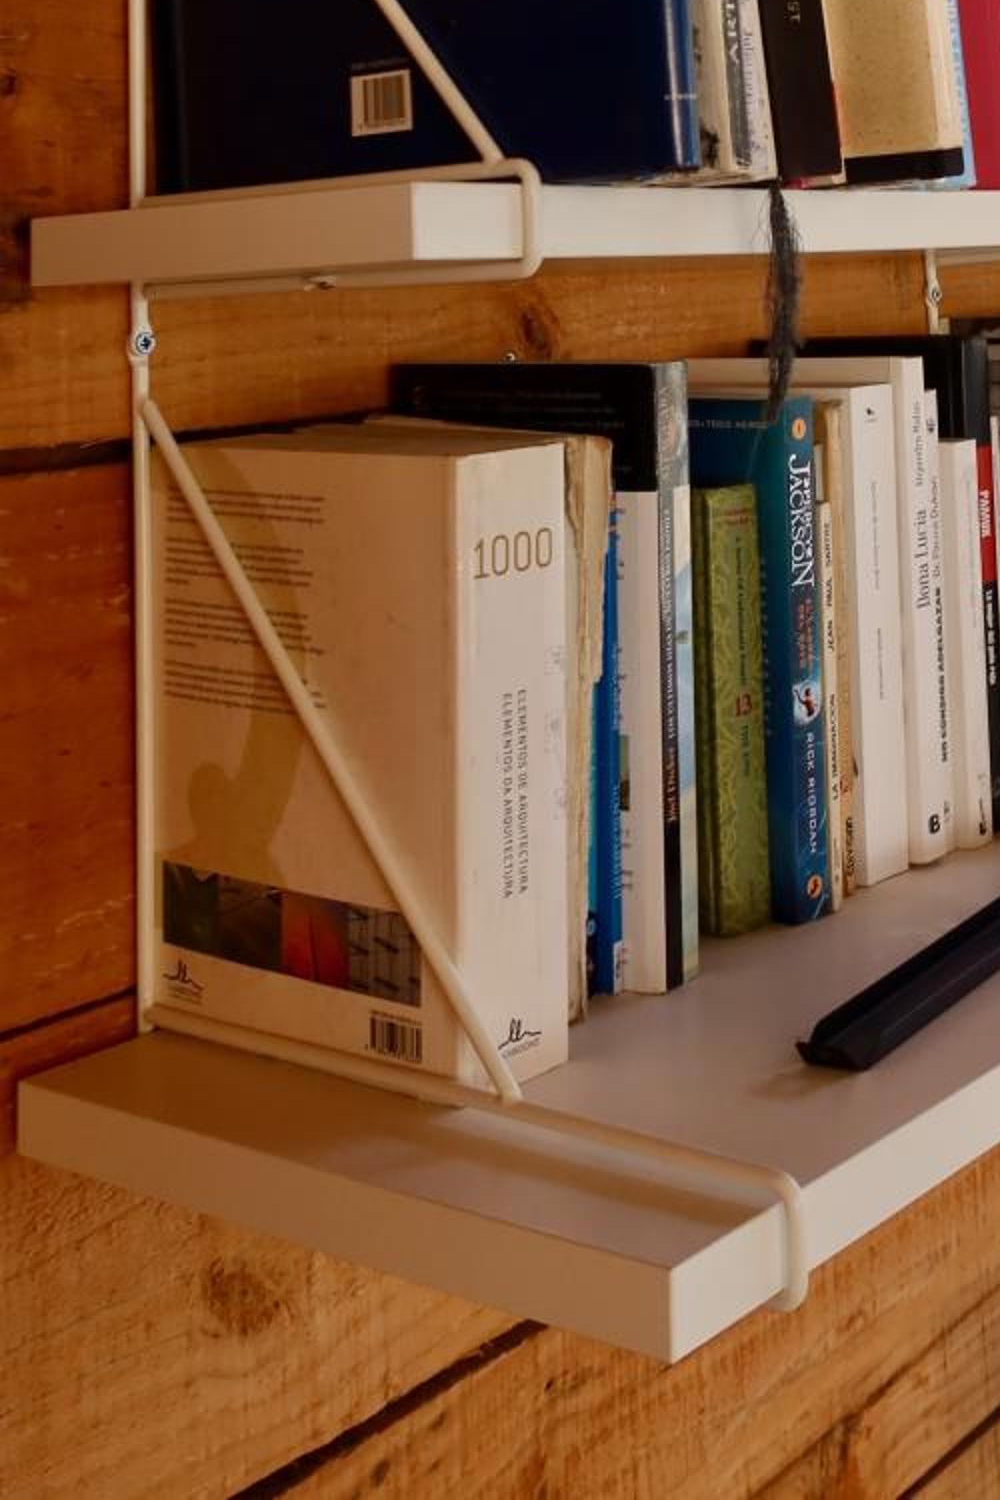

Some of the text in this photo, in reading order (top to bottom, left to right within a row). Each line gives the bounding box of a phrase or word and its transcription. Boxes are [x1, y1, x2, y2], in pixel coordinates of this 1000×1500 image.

[473, 527, 552, 579] 1000
[788, 453, 814, 588] JACKSON
[978, 489, 993, 540] PAMUK
[824, 523, 836, 652] JEAN PAUL SARTRE
[502, 692, 514, 900] ELEMENTOS DA ARQUITECTURA
[517, 689, 528, 896] ELEMENTOS DE ARQUITECTURA
[807, 731, 817, 854] RICK RIORDAN
